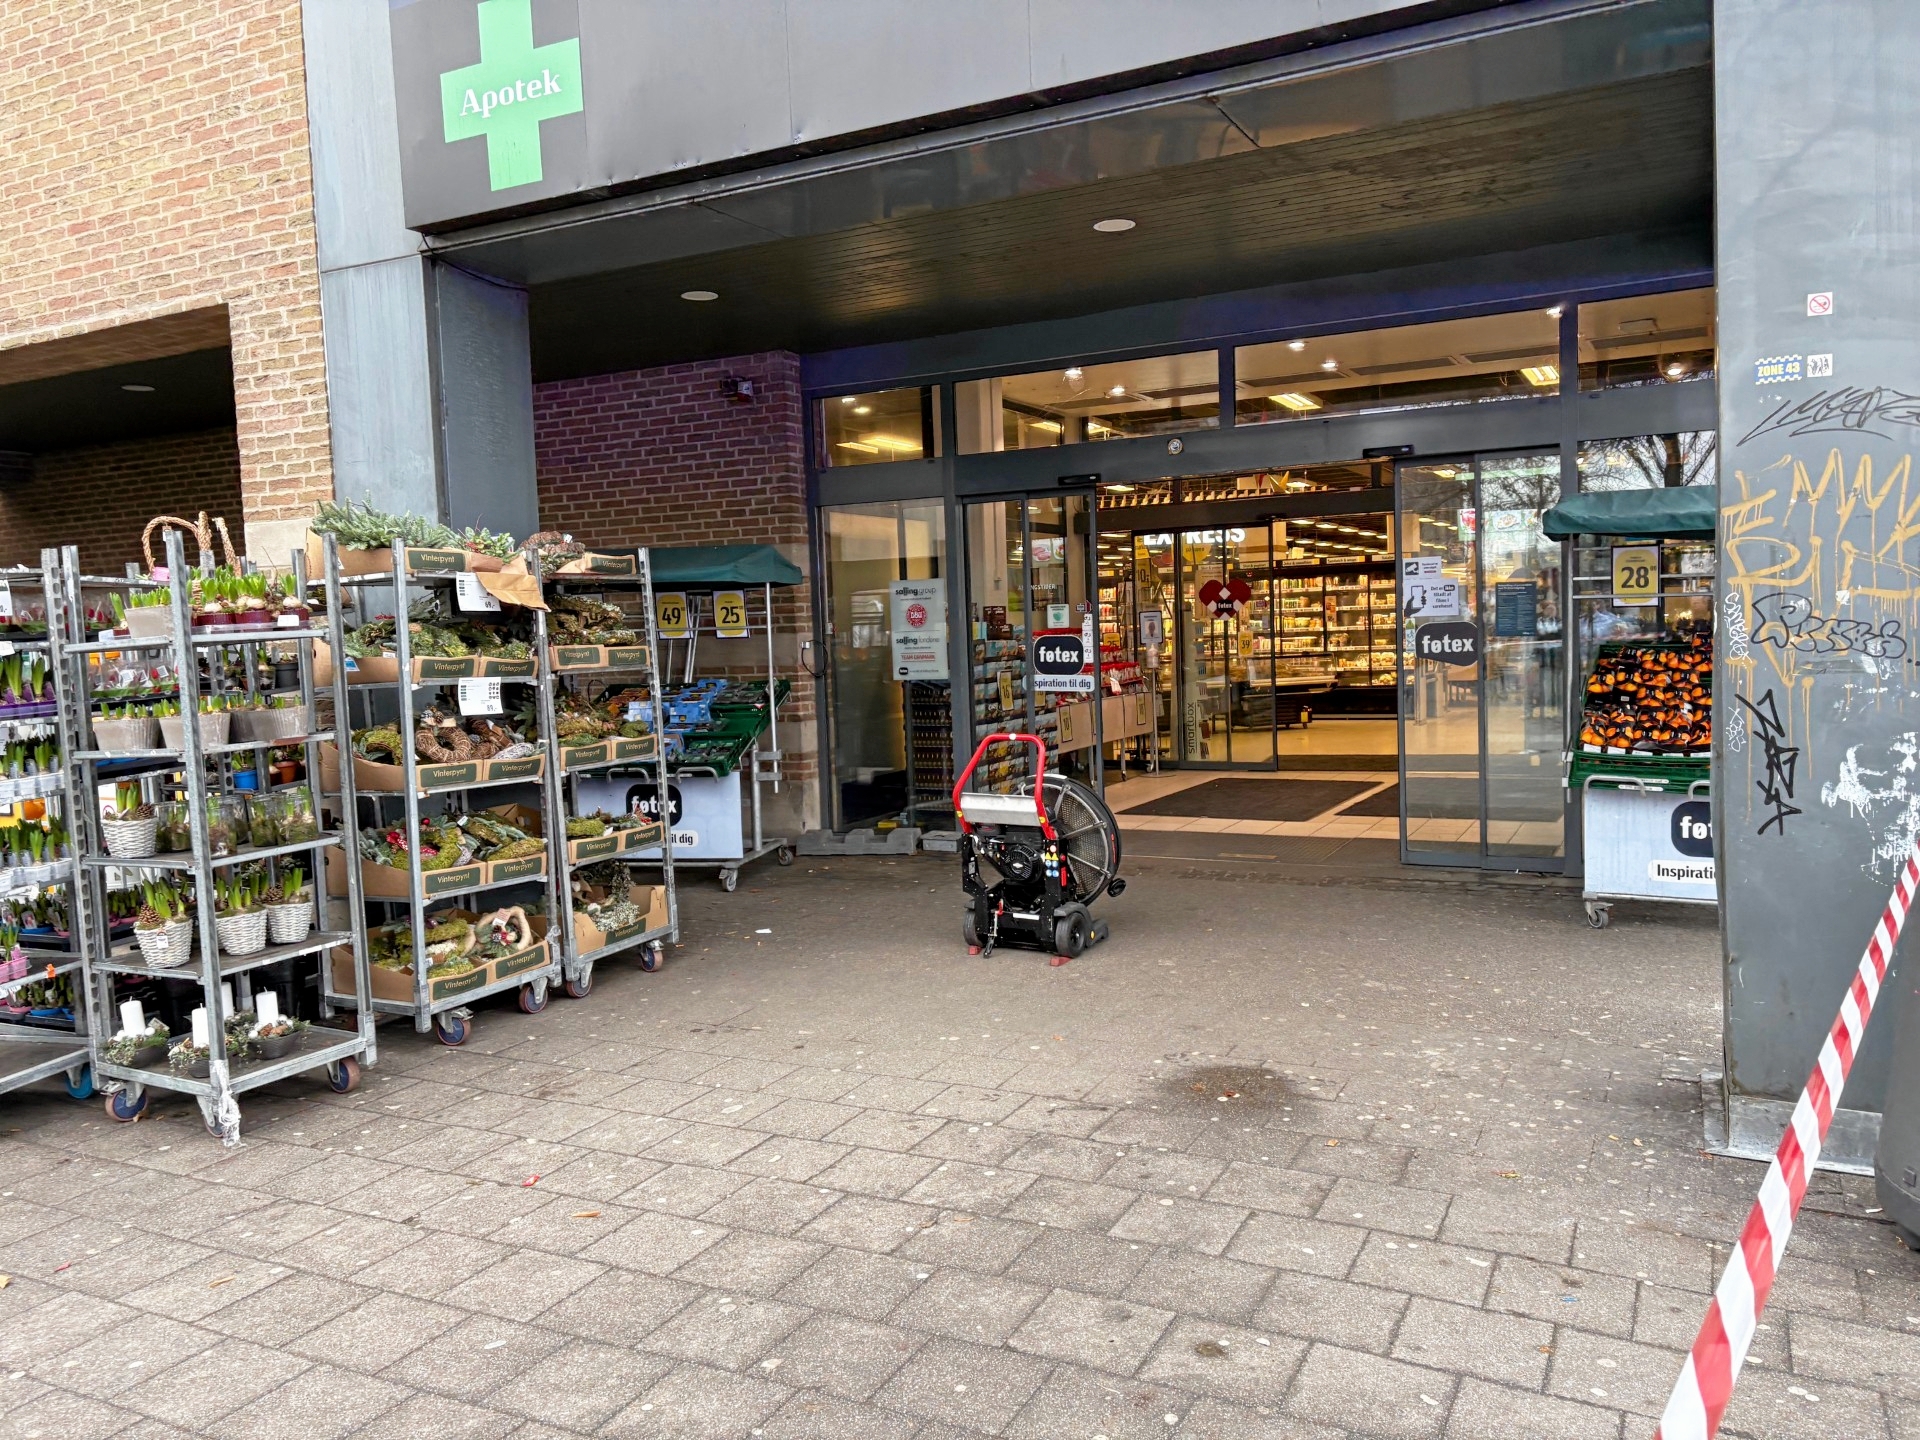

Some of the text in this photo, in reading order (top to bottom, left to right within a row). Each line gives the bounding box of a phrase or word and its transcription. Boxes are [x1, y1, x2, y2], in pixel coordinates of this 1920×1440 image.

[459, 68, 562, 118] Apotek
[1757, 361, 1801, 377] ZONE 43
[1143, 528, 1246, 545] EXRESS
[420, 553, 455, 564] Vinterpynt
[1621, 566, 1650, 588] 28
[662, 607, 681, 625] 49
[720, 606, 740, 624] 25
[1422, 634, 1474, 654] føtex
[1038, 646, 1079, 663] føtex
[434, 662, 465, 671] Vinterpynt
[1034, 678, 1091, 691] spiration til dig
[1186, 702, 1196, 754] smartbox
[432, 767, 467, 778] Vinterpynt
[631, 795, 677, 814] føtx
[679, 833, 694, 846] dig
[504, 862, 534, 873] Vinterpynt
[1657, 863, 1716, 881] Inspirati
[437, 871, 470, 884] Vinterpynt
[506, 951, 536, 968] Vinterpynt
[444, 975, 478, 989] Vinterpynt
